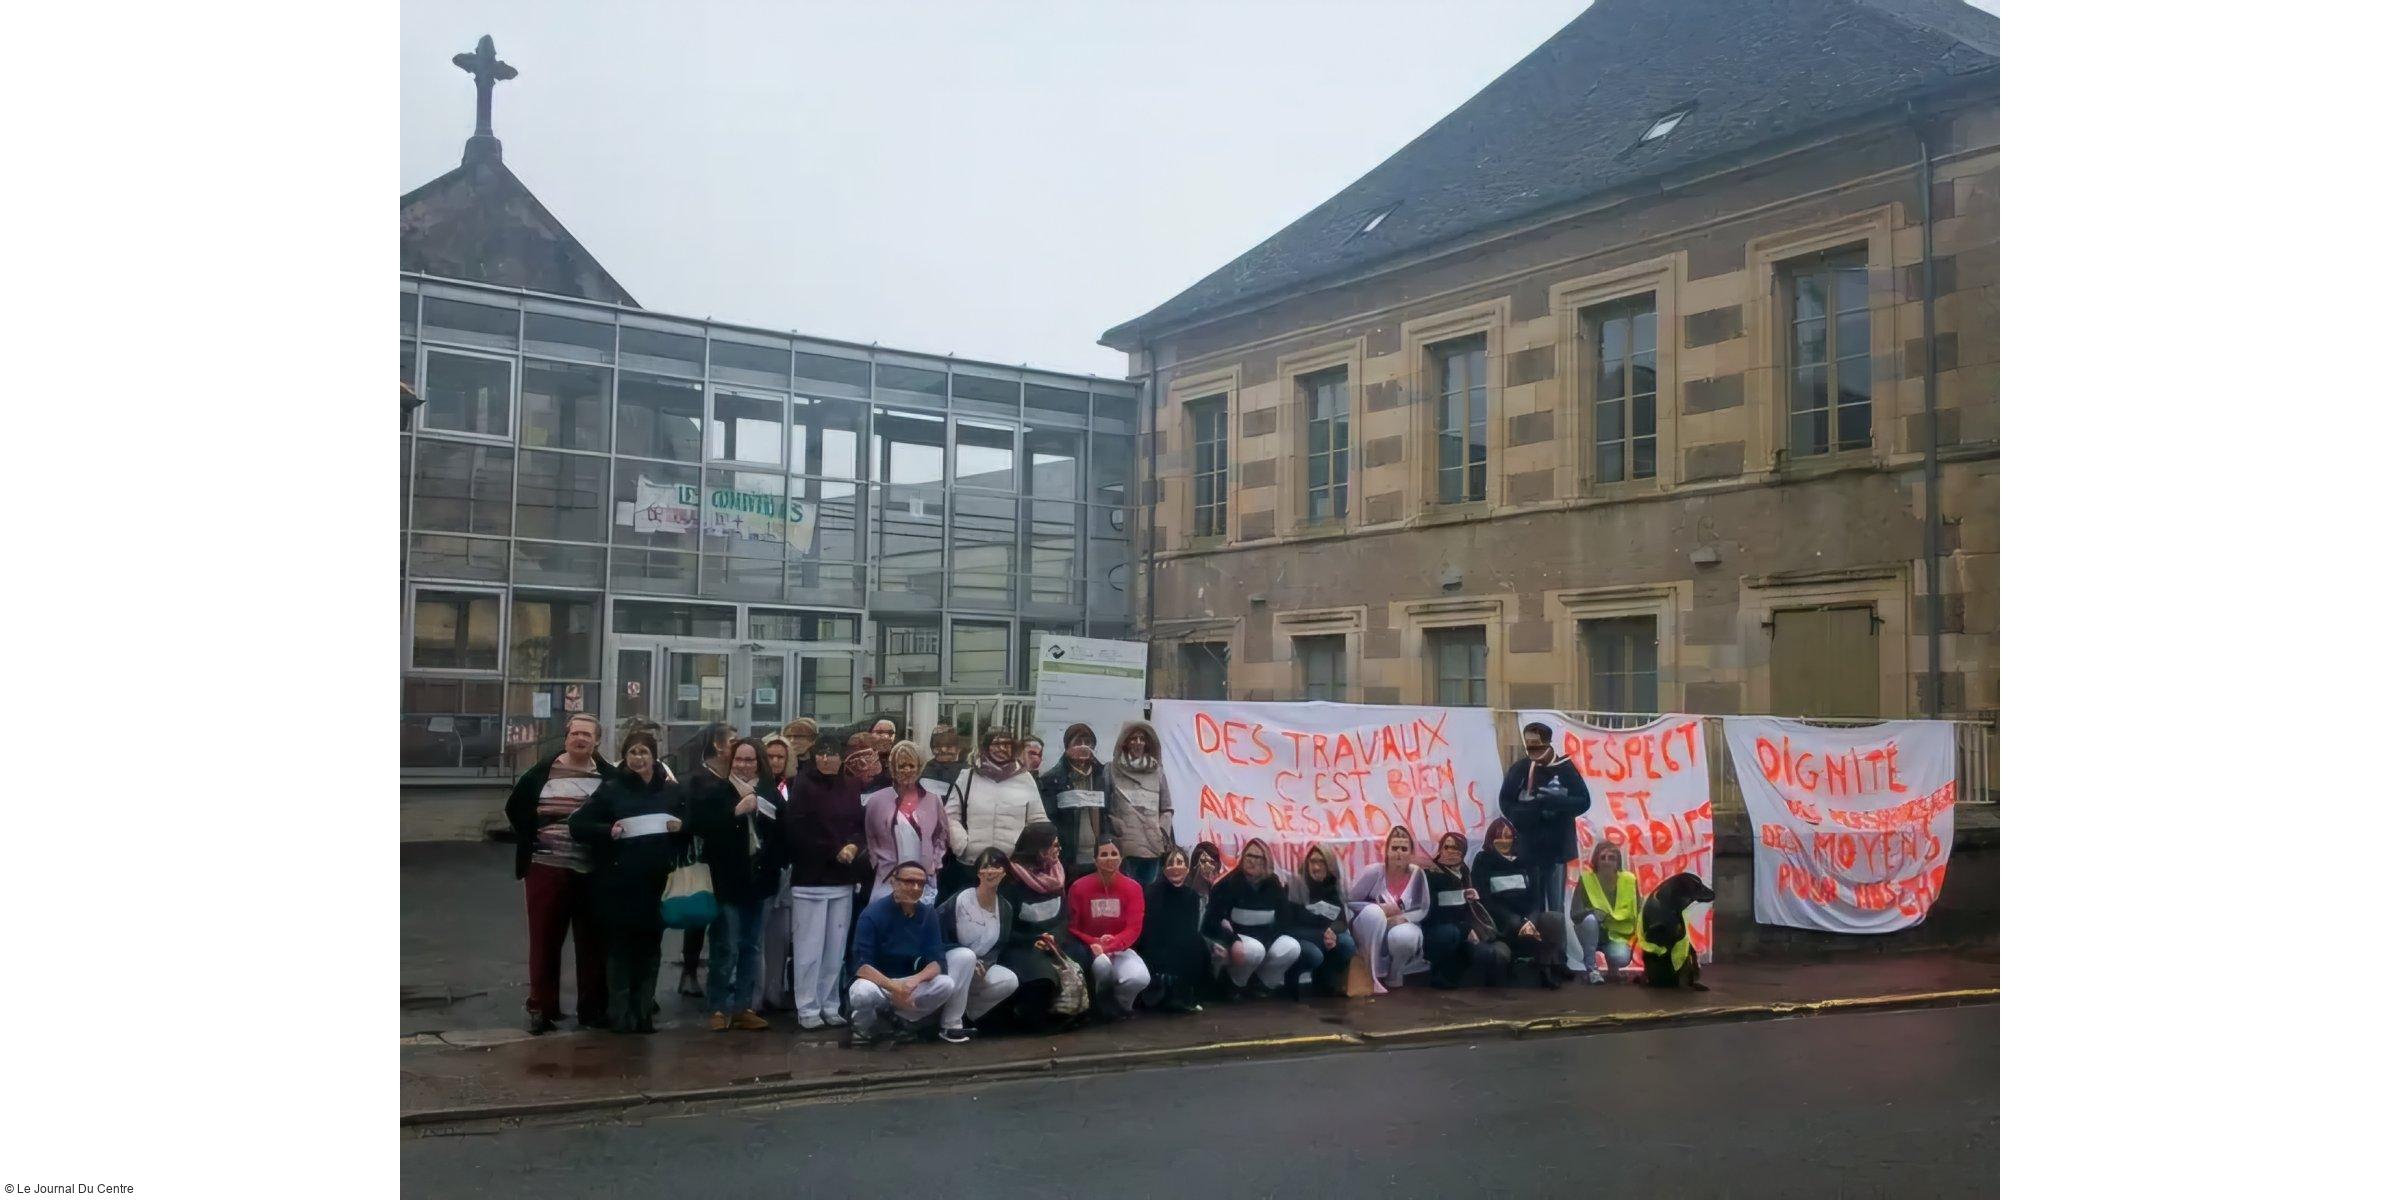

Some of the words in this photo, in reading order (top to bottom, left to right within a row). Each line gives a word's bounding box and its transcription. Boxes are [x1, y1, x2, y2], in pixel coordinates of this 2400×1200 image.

[1194, 712, 1273, 766] DES
[1281, 712, 1450, 771] TRAVAUX
[1563, 721, 1698, 782] RESPECT
[1755, 735, 1908, 796] DIGNITÉ
[1387, 759, 1457, 800] BIEN
[1605, 791, 1652, 821] ET
[1199, 784, 1264, 829] AVEC
[1266, 801, 1321, 836] DES
[1325, 780, 1487, 840] MOYENS
[1812, 822, 1941, 874] MOYENS
